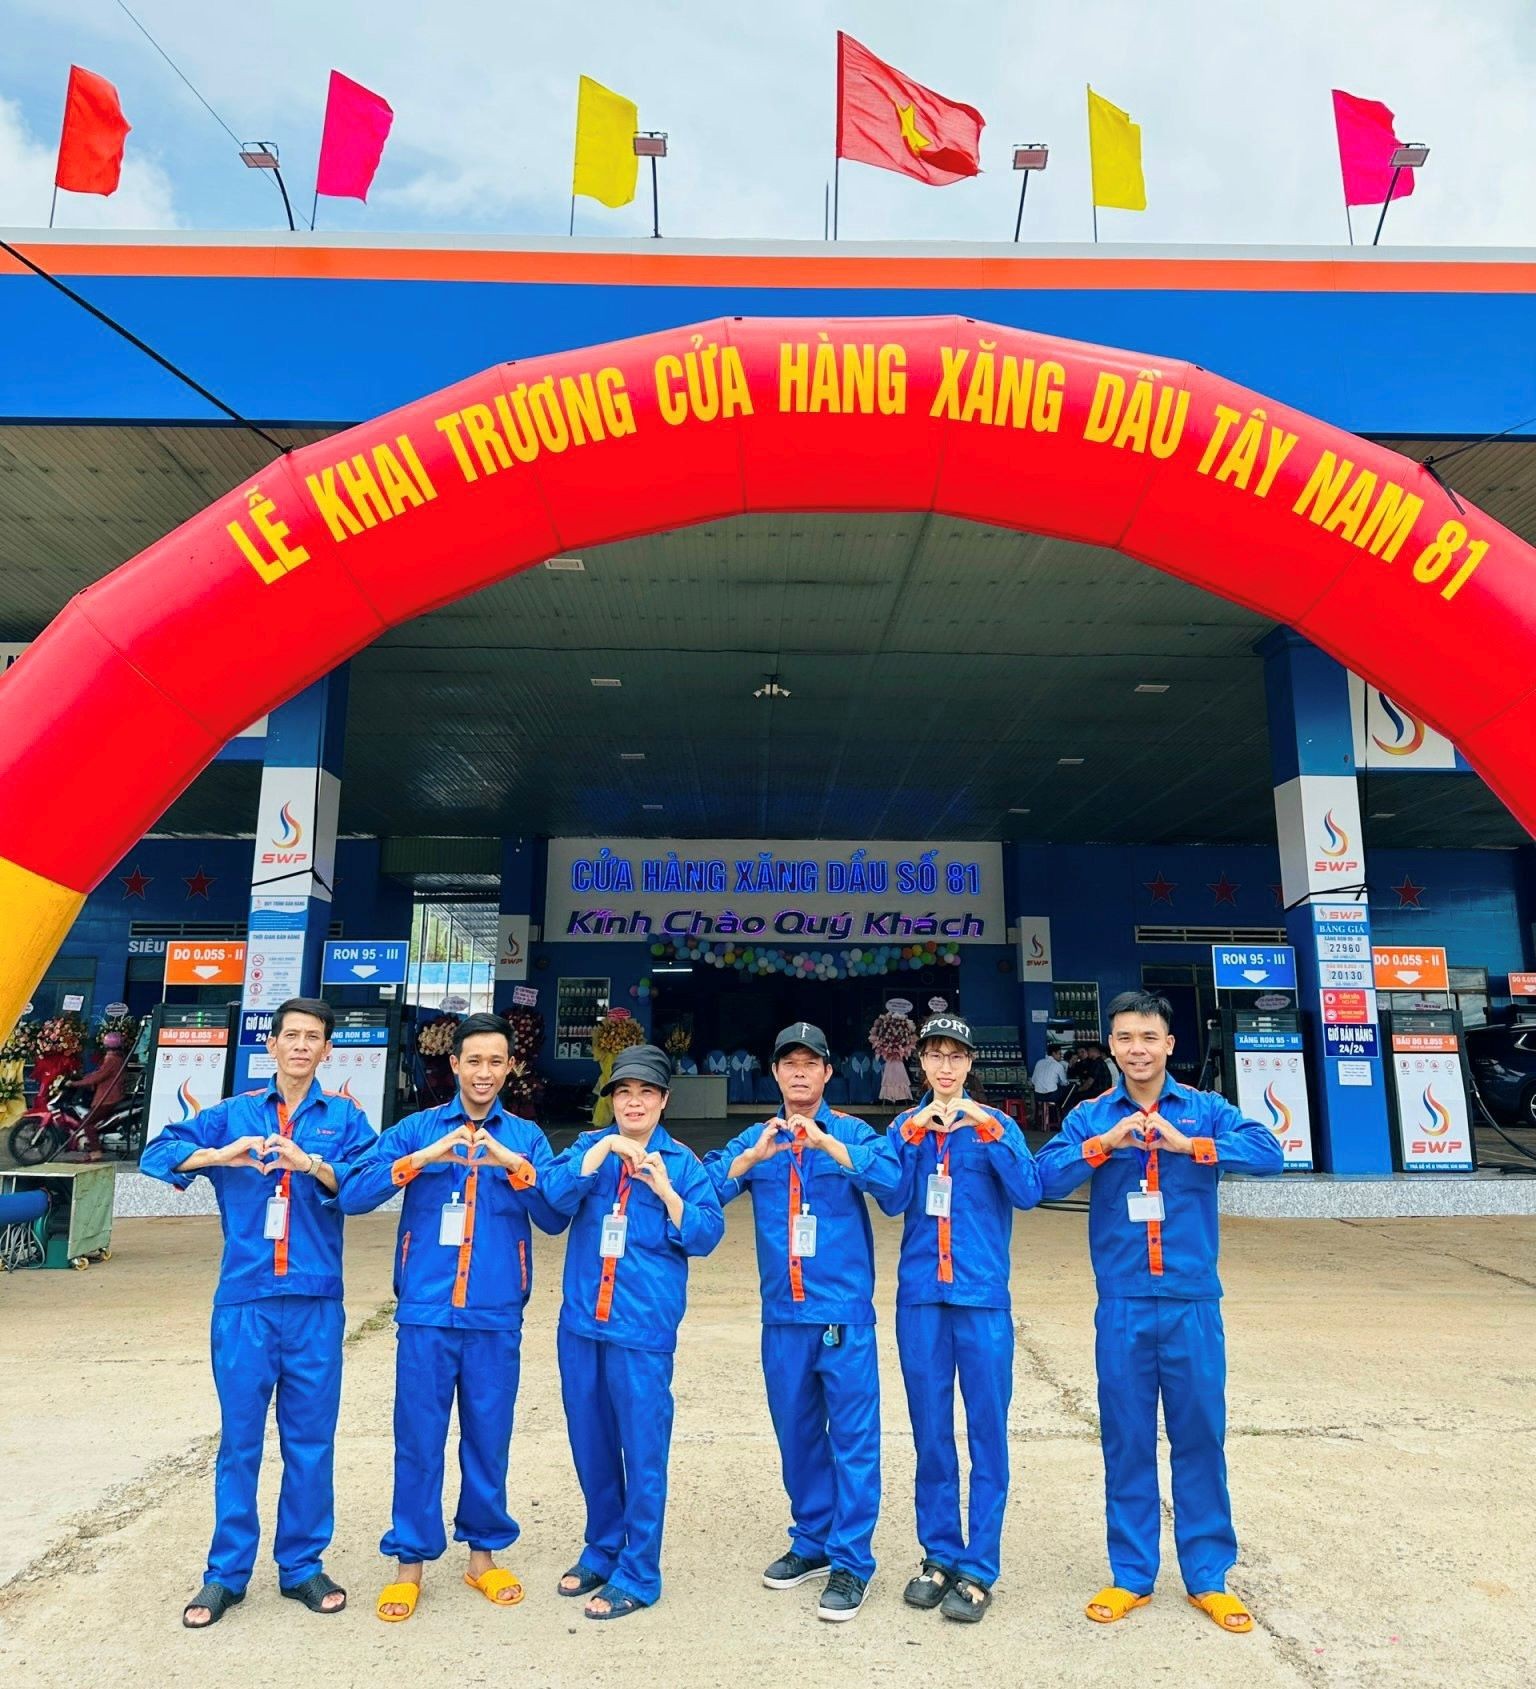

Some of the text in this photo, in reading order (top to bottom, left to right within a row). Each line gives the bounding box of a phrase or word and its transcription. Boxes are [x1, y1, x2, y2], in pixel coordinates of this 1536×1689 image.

[227, 332, 1490, 601] LỄ KHAI TRƯƠNG CỬA HÀNG XĂNG DẦU TÂY NAM 81
[261, 853, 307, 864] SWP
[572, 847, 981, 895] CỬA HÀNG XĂNG DẦU SỐ 81
[1314, 861, 1358, 872] SWP
[1329, 911, 1363, 919] SWP
[567, 908, 985, 940] Kính Chào Quý Khách
[1319, 923, 1365, 933] BẢNG GIÁ
[128, 938, 165, 953] SIÊU
[1329, 943, 1360, 953] 22960
[174, 949, 190, 960] DO
[194, 949, 225, 960] 0.05S
[235, 948, 244, 960] II
[333, 949, 359, 960] RON
[362, 949, 376, 960] 95
[387, 948, 399, 960] III
[1222, 953, 1247, 965] RON
[1250, 954, 1263, 965] 95
[1274, 954, 1285, 965] III
[1373, 954, 1389, 966] DO
[1392, 955, 1422, 966] 0.05S
[1431, 954, 1440, 966] II
[500, 957, 523, 965] SWP
[1331, 971, 1362, 980] 20130
[920, 1018, 970, 1038] SPORT
[1328, 1025, 1374, 1042] GIỜ BÁN HÀNG
[1260, 1036, 1275, 1044] RON
[1276, 1036, 1285, 1044] 95
[1339, 1042, 1364, 1055] 24/24
[1411, 1141, 1462, 1153] SWP
